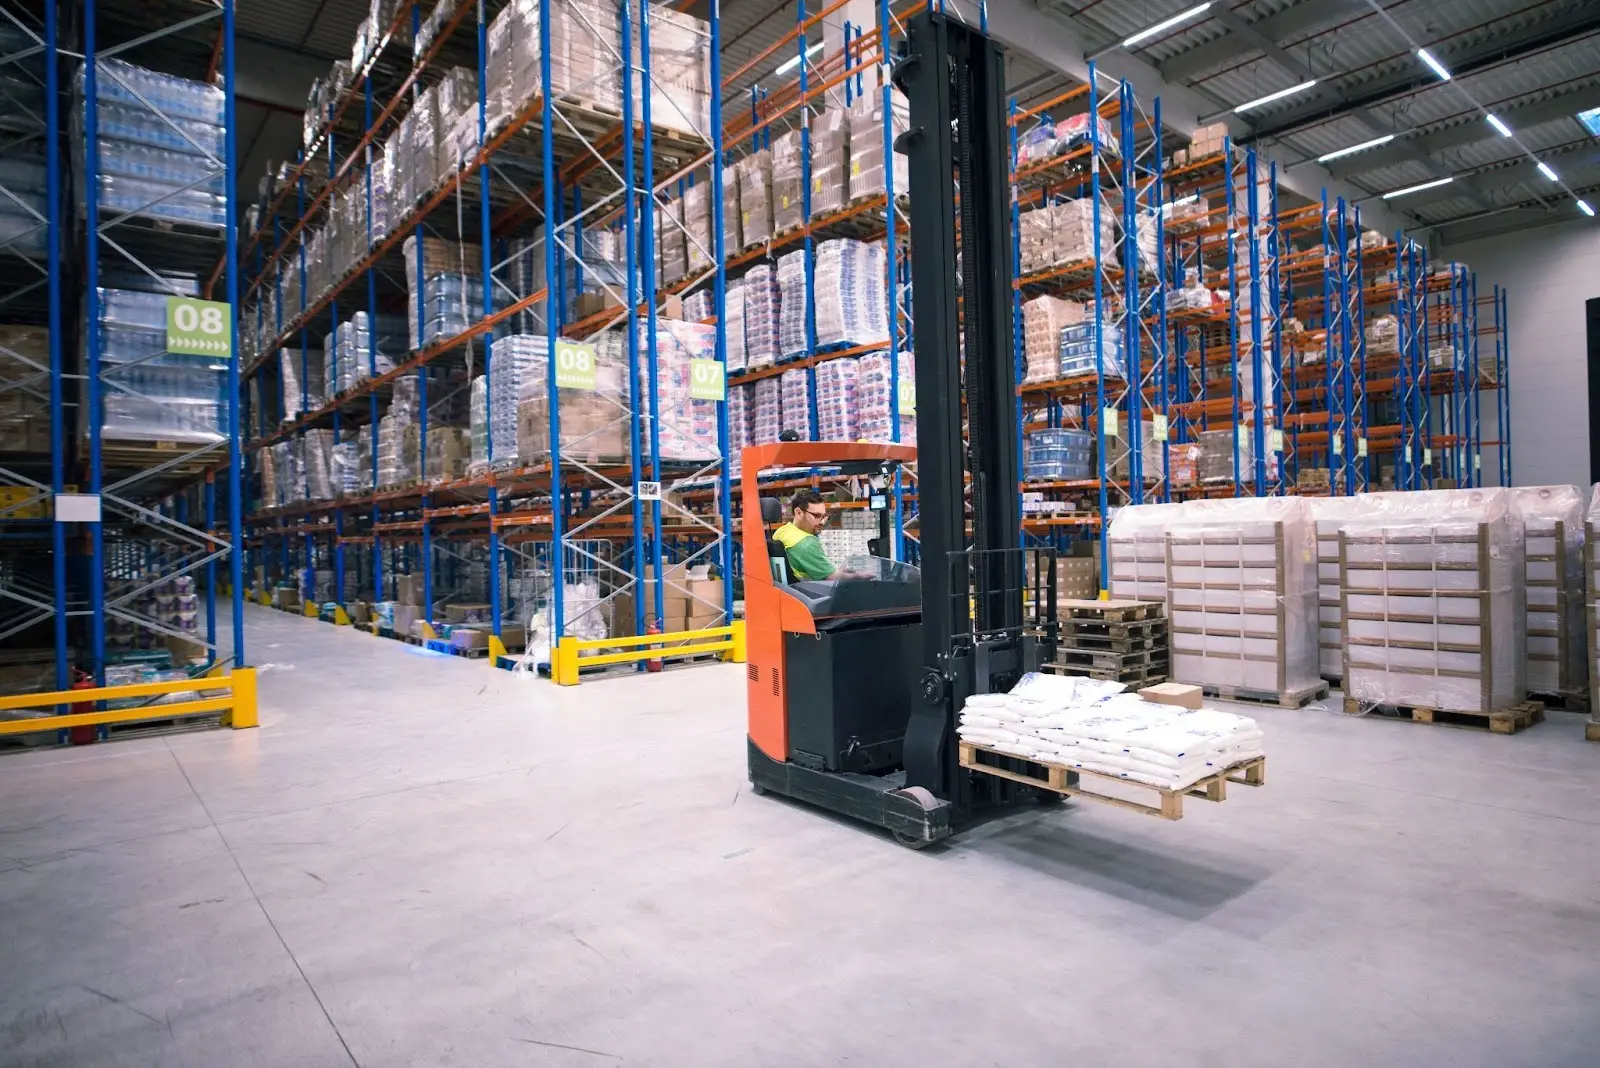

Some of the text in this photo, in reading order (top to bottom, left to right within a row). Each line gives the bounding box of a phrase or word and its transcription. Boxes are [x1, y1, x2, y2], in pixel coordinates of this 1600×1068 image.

[174, 304, 224, 334] 08
[560, 348, 590, 371] 08
[694, 363, 720, 384] 07
